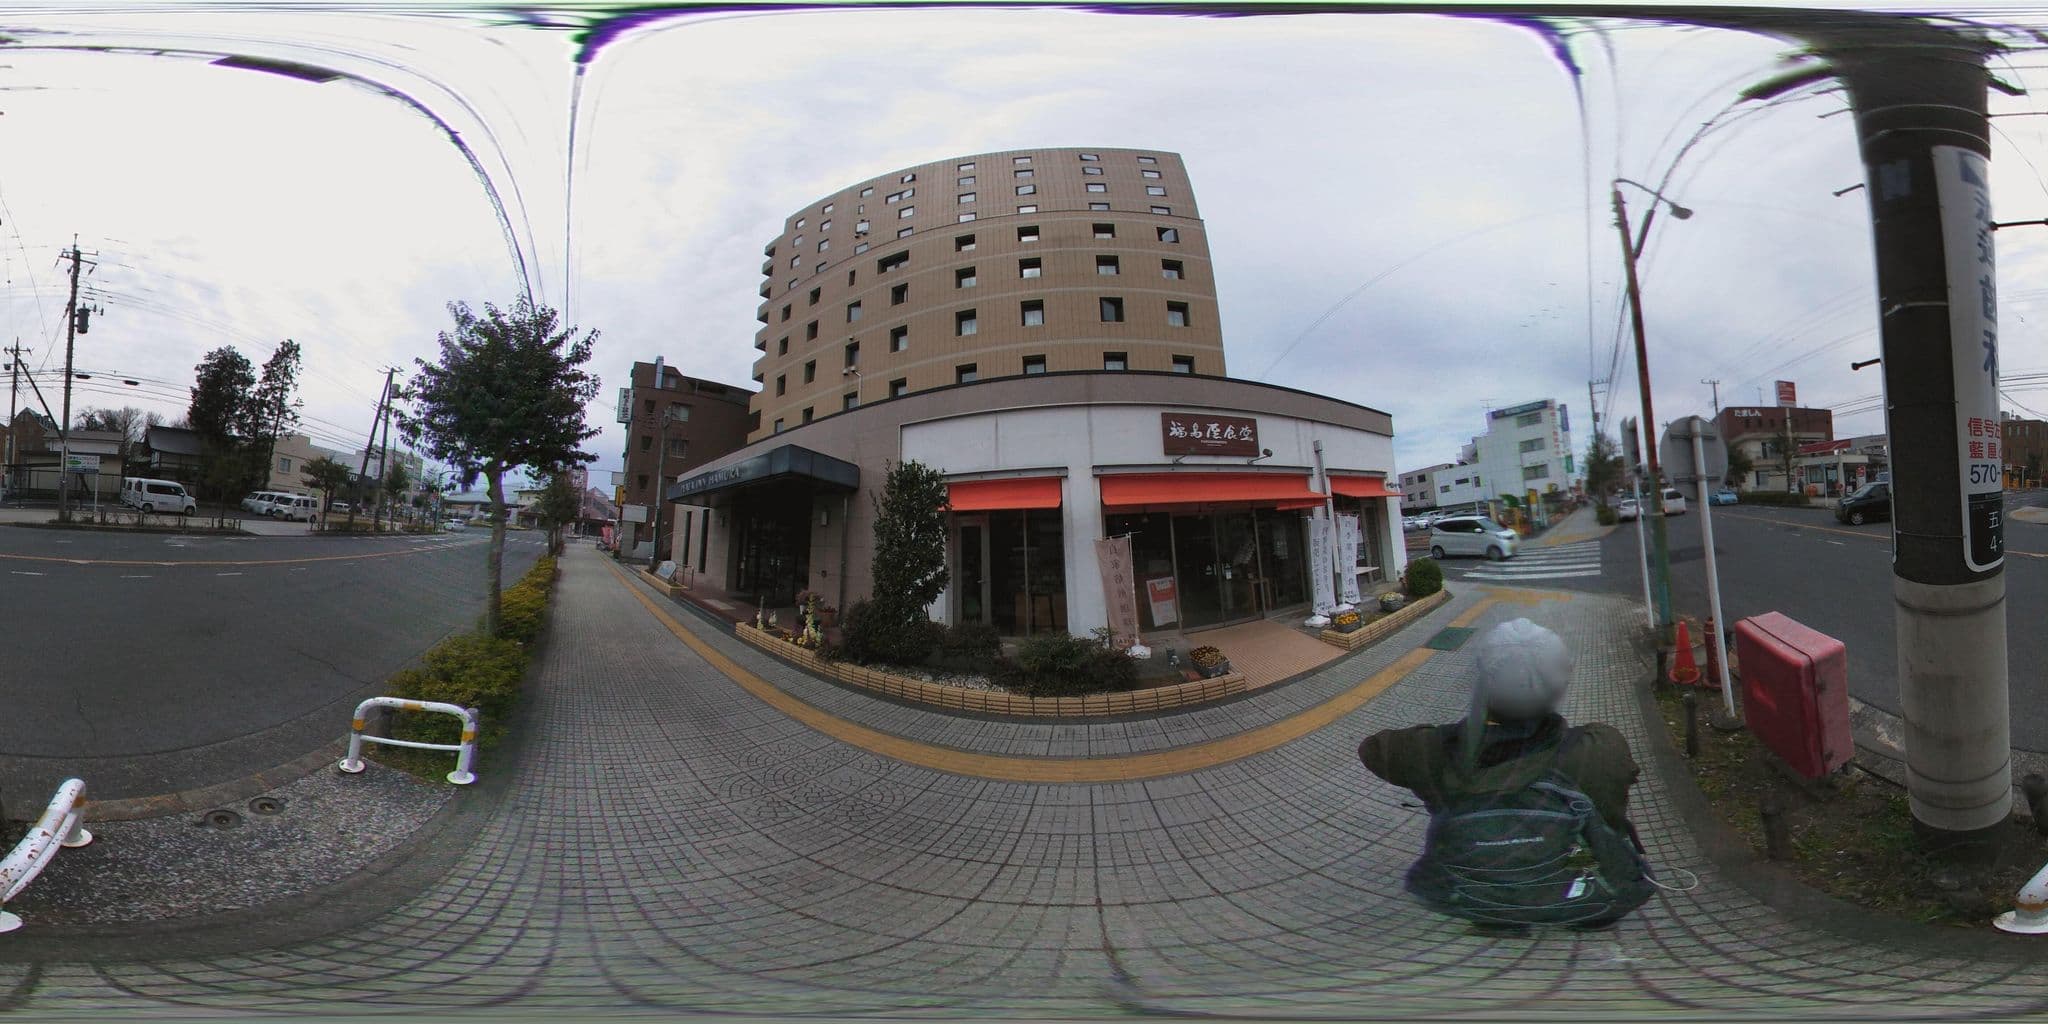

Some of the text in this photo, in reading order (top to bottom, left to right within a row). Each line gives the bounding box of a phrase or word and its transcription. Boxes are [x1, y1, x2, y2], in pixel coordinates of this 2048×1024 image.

[1169, 420, 1254, 441] 福島屋食堂
